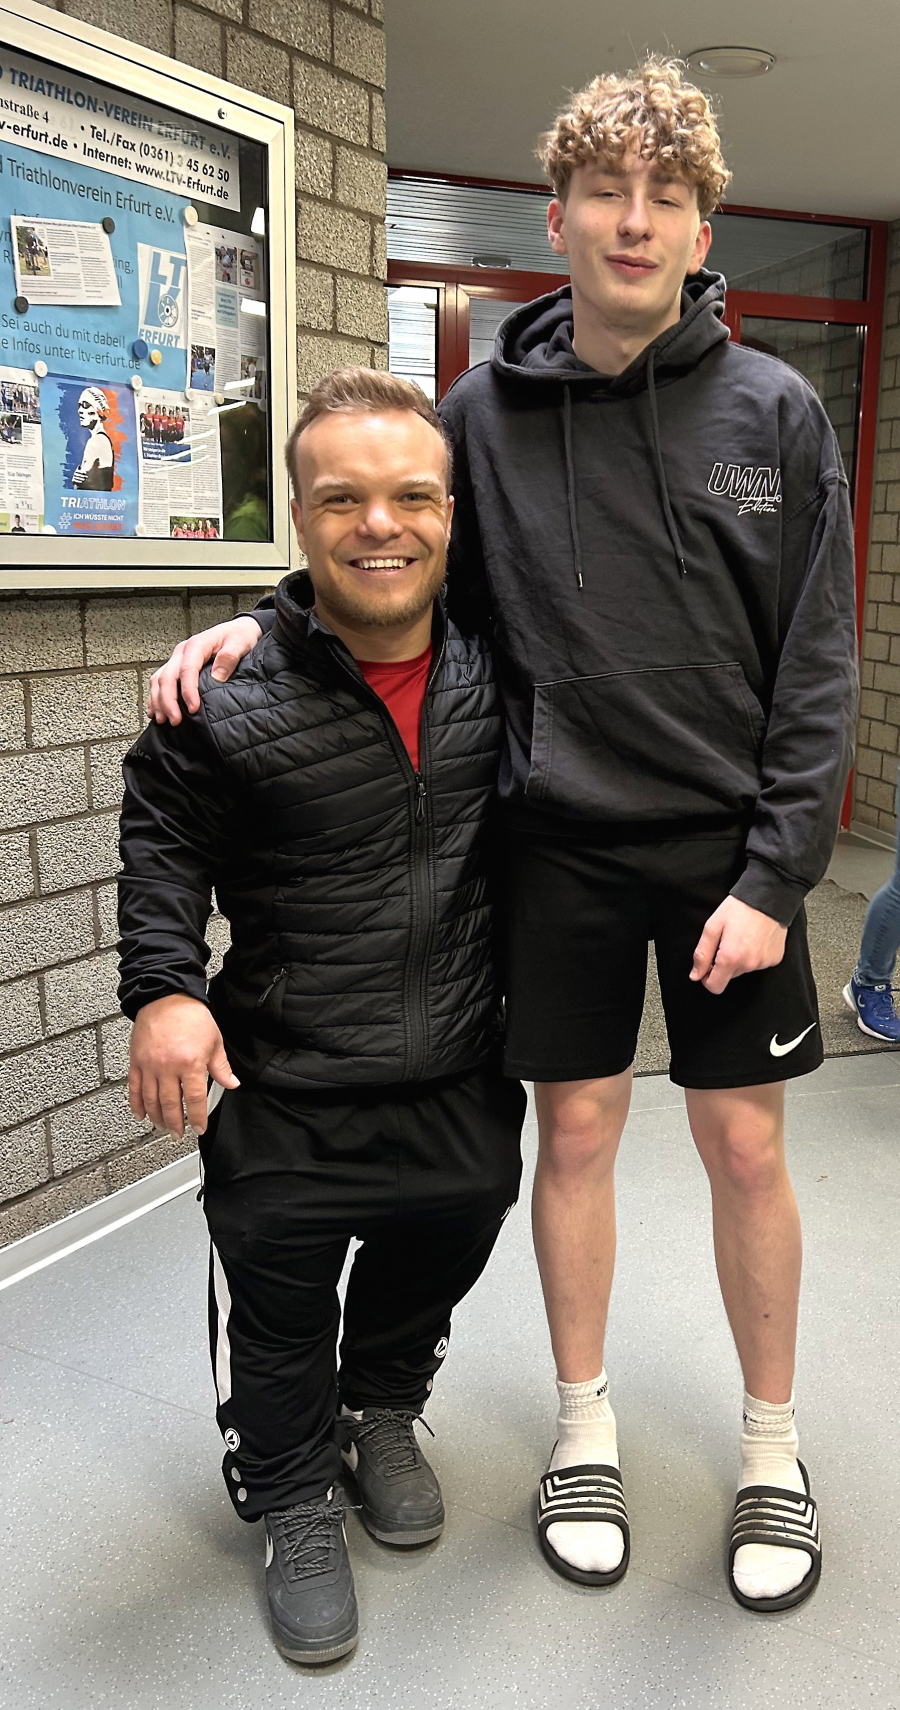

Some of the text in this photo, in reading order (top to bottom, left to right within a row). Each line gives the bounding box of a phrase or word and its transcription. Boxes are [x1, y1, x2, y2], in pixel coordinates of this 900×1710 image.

[10, 67, 153, 133] TRIATHLON-VEREIN
[157, 121, 206, 150] ERFURT
[209, 143, 231, 159] e.V.
[42, 110, 50, 124] 4
[90, 124, 136, 153] Tel./Fax
[139, 142, 174, 167] (0361)
[186, 158, 199, 173] 45
[202, 163, 215, 178] 62
[217, 169, 230, 183] 50
[82, 142, 132, 170] Internet:
[135, 162, 229, 200] www.LTV-Erfurt.de
[7, 157, 112, 206] Triathlonverein
[116, 190, 151, 217] Erfurt
[155, 205, 175, 223] e.V.
[1, 313, 126, 349] Sei auch du mit dabei!
[139, 328, 180, 348] ERFURT
[12, 336, 41, 355] Infos
[44, 346, 75, 361] unter
[78, 347, 141, 371] ltv-erfurt.de
[60, 496, 126, 511] TRIATHLON
[735, 496, 778, 516] Edition
